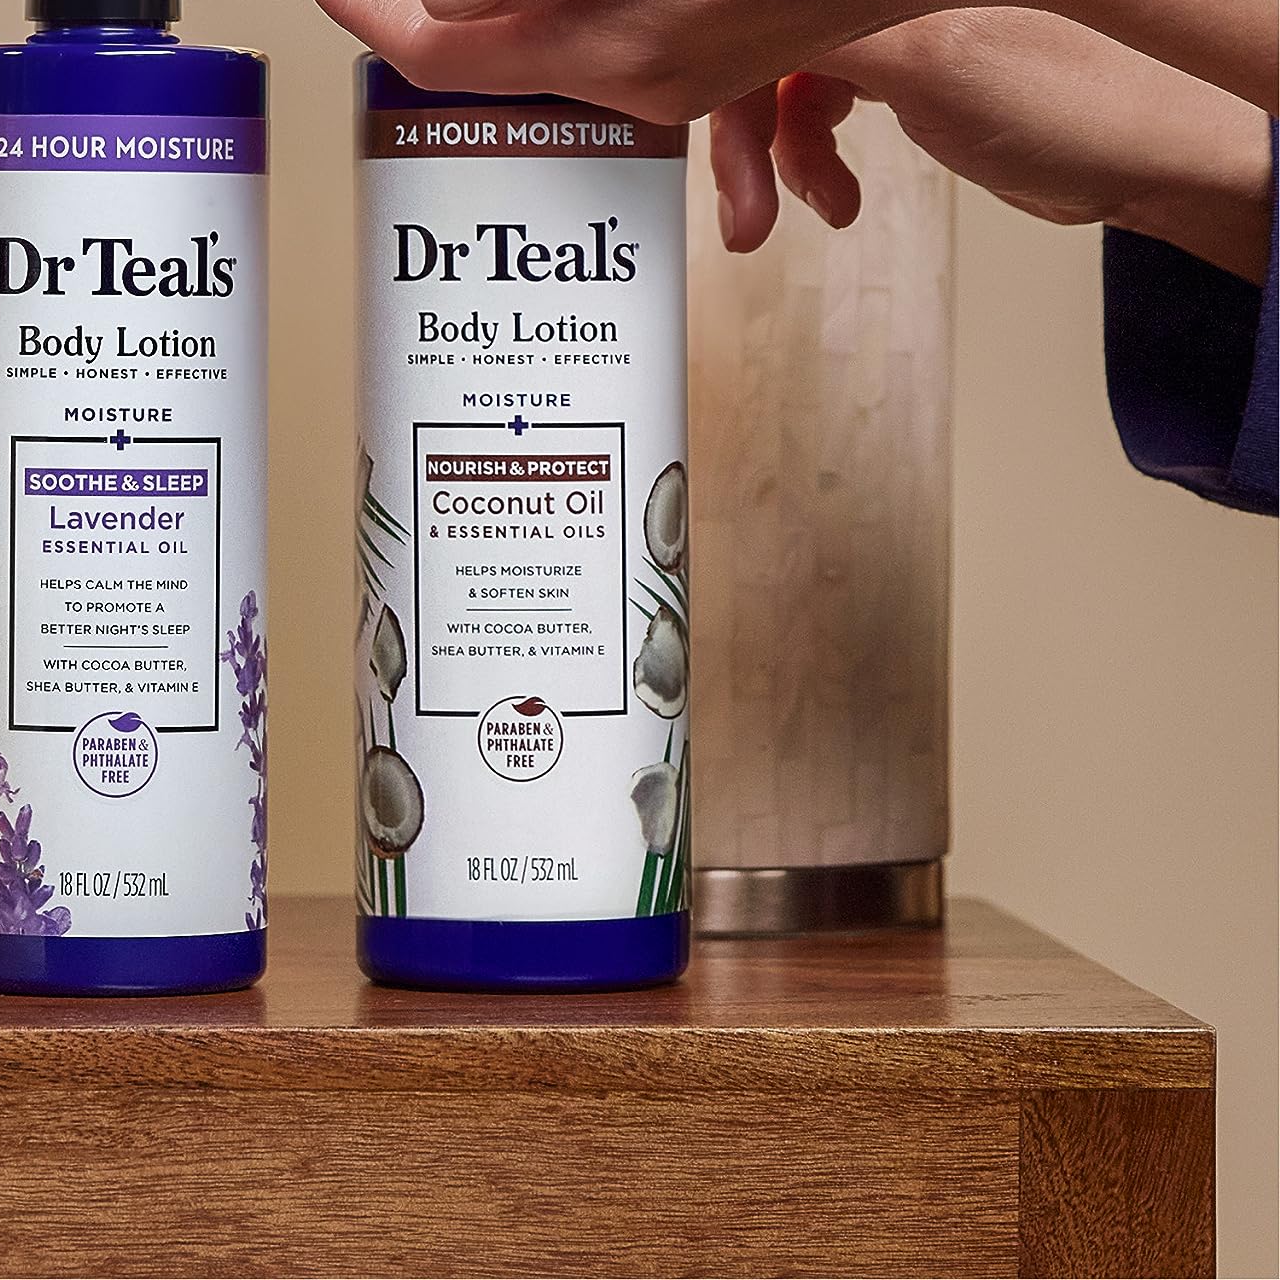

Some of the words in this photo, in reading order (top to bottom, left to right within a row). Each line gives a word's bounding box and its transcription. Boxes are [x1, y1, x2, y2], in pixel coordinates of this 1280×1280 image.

[396, 125, 419, 144] 24
[427, 122, 497, 144] HOUR
[508, 122, 634, 145] MOISTURE
[32, 136, 106, 158] HOUR
[117, 137, 233, 159] MOISTURE
[393, 224, 469, 281] Dr
[477, 216, 635, 282] Teal's
[83, 231, 233, 297] Teal's
[419, 312, 498, 349] Body
[513, 313, 617, 342] Lotion
[19, 326, 103, 364] Body
[117, 327, 216, 357] Lotion
[407, 353, 455, 365] SIMPLE
[472, 354, 535, 365] HONEST
[554, 353, 631, 365] EFFECTIVE
[6, 366, 57, 379] SIMPLE
[75, 368, 139, 380] HONEST
[156, 368, 227, 380] EFFECTIVE
[463, 393, 571, 408] MOISTURE
[64, 407, 173, 423] MOISTURE
[30, 474, 117, 490] SOOTHE
[143, 475, 203, 491] SLEEP
[433, 491, 554, 514] Coconut
[566, 490, 602, 514] Oil
[51, 506, 184, 530] Lavender
[447, 525, 555, 539] ESSENTIAL
[563, 525, 605, 539] OILS
[42, 539, 150, 554] ESSENTIAL
[158, 540, 188, 554] OIL
[455, 565, 497, 577] HELPS
[500, 565, 583, 577] MOISTURIZE
[40, 578, 82, 590] HELPS
[85, 579, 123, 591] CALM
[126, 579, 153, 591] THE
[156, 579, 189, 590] MIND
[480, 587, 535, 599] SOFTEN
[538, 587, 569, 599] SKIN
[64, 601, 83, 613] TO
[86, 601, 152, 613] PROMOTE
[155, 602, 165, 613] A
[40, 623, 92, 635] BETTER
[95, 624, 149, 636] NIGHT'S
[151, 624, 191, 636] SLEEP
[446, 623, 481, 634] WITH
[483, 623, 534, 635] COCOA
[537, 622, 593, 635] BUTTER,
[431, 645, 465, 657] SHEA
[468, 645, 525, 658] BUTTER,
[540, 645, 595, 656] VITAMIN
[42, 659, 78, 671] WITH
[81, 659, 131, 671] COCOA
[134, 659, 187, 672] BUTTER,
[26, 680, 62, 693] SHEA
[64, 681, 122, 695] BUTTER,
[137, 682, 189, 693] VITAMIN
[486, 721, 541, 736] PARABEN
[82, 737, 137, 751] PARABEN
[487, 737, 554, 752] PHTHALATE
[82, 753, 149, 768] PHTHALATE
[506, 754, 535, 768] FREE
[101, 769, 130, 784] FREE
[467, 857, 480, 880] 18
[484, 858, 497, 880] FL
[501, 858, 518, 881] OZ
[532, 858, 554, 881] 532
[558, 858, 578, 880] mL
[60, 872, 72, 896] 18
[77, 873, 90, 896] FL
[94, 873, 110, 896] OZ
[124, 873, 145, 896] 532
[150, 873, 169, 896] mL
